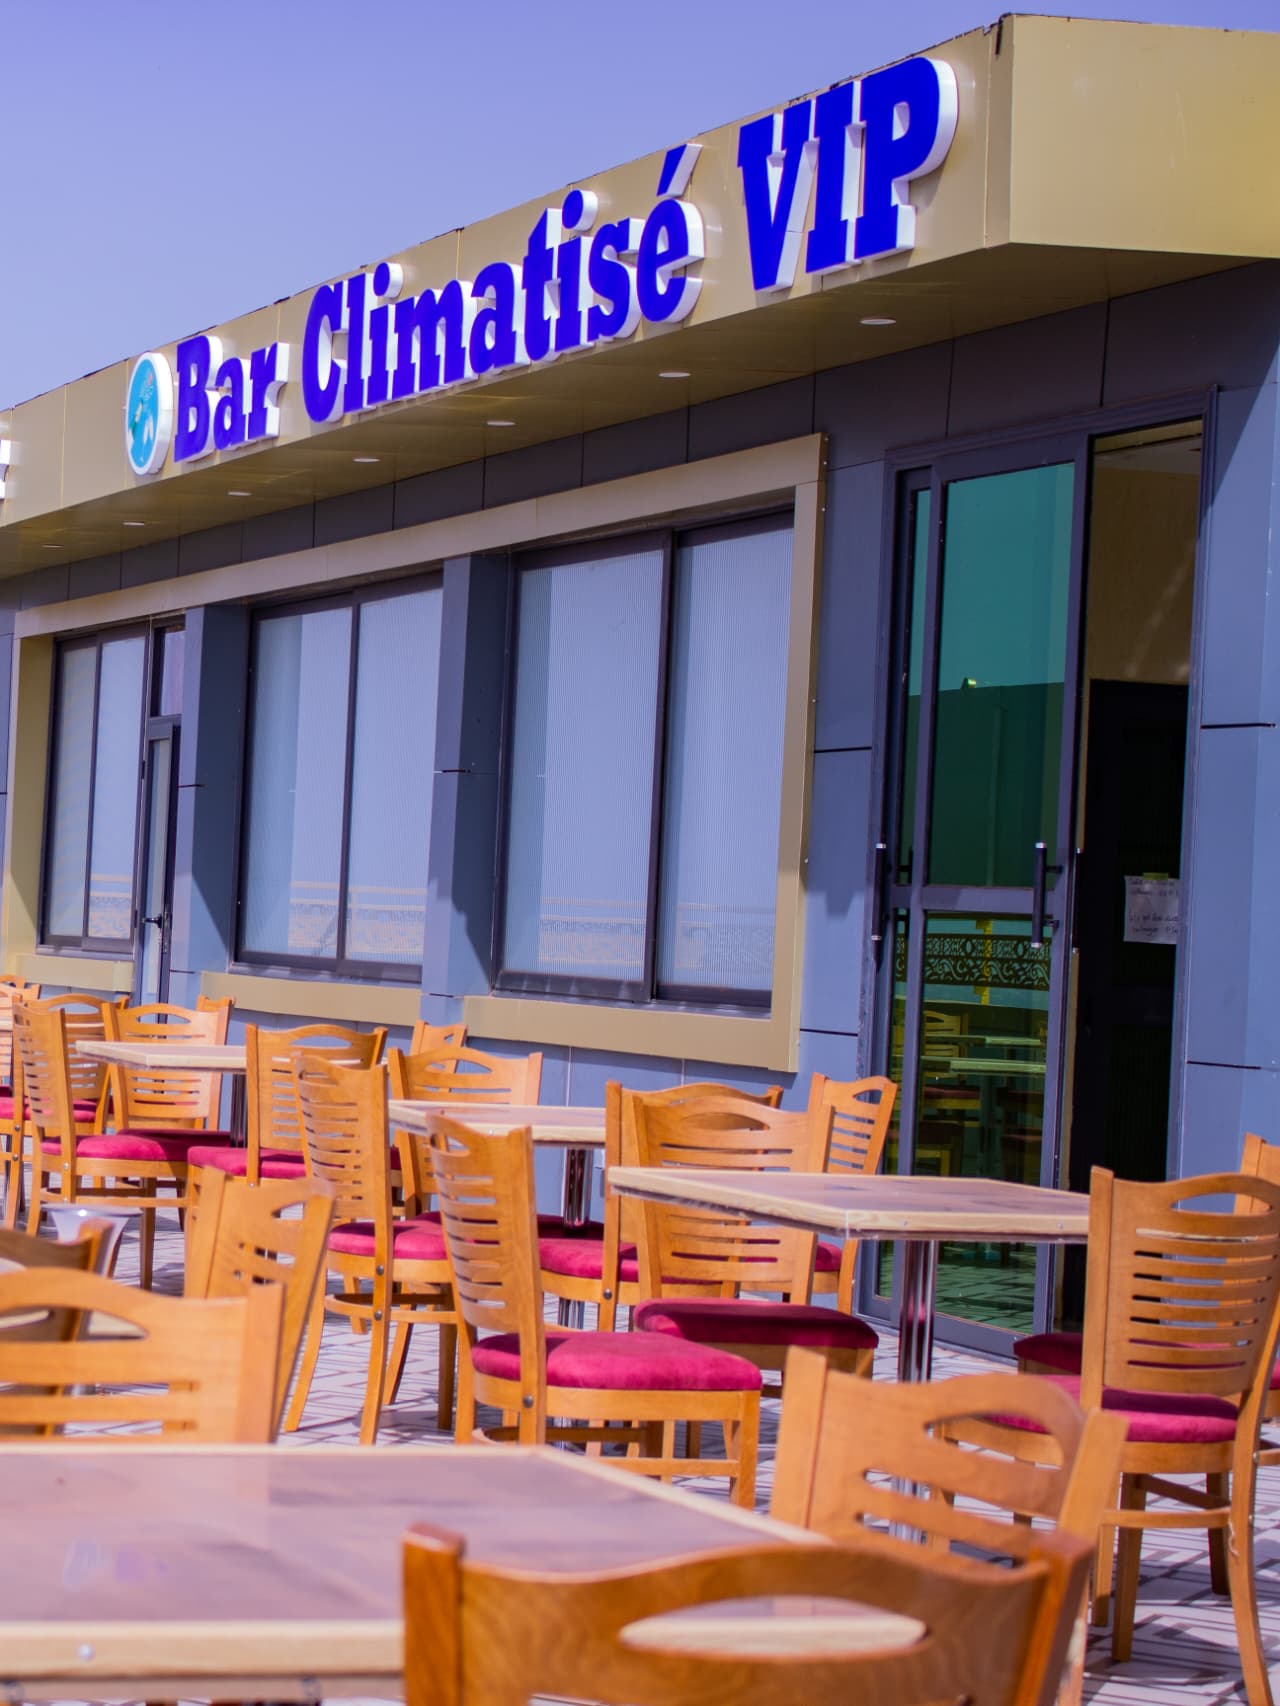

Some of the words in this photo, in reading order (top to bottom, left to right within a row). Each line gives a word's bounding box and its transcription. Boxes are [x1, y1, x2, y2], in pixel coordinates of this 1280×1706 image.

[174, 335, 282, 463] Bar
[302, 143, 692, 424] Climatisé
[736, 56, 946, 292] VIP
